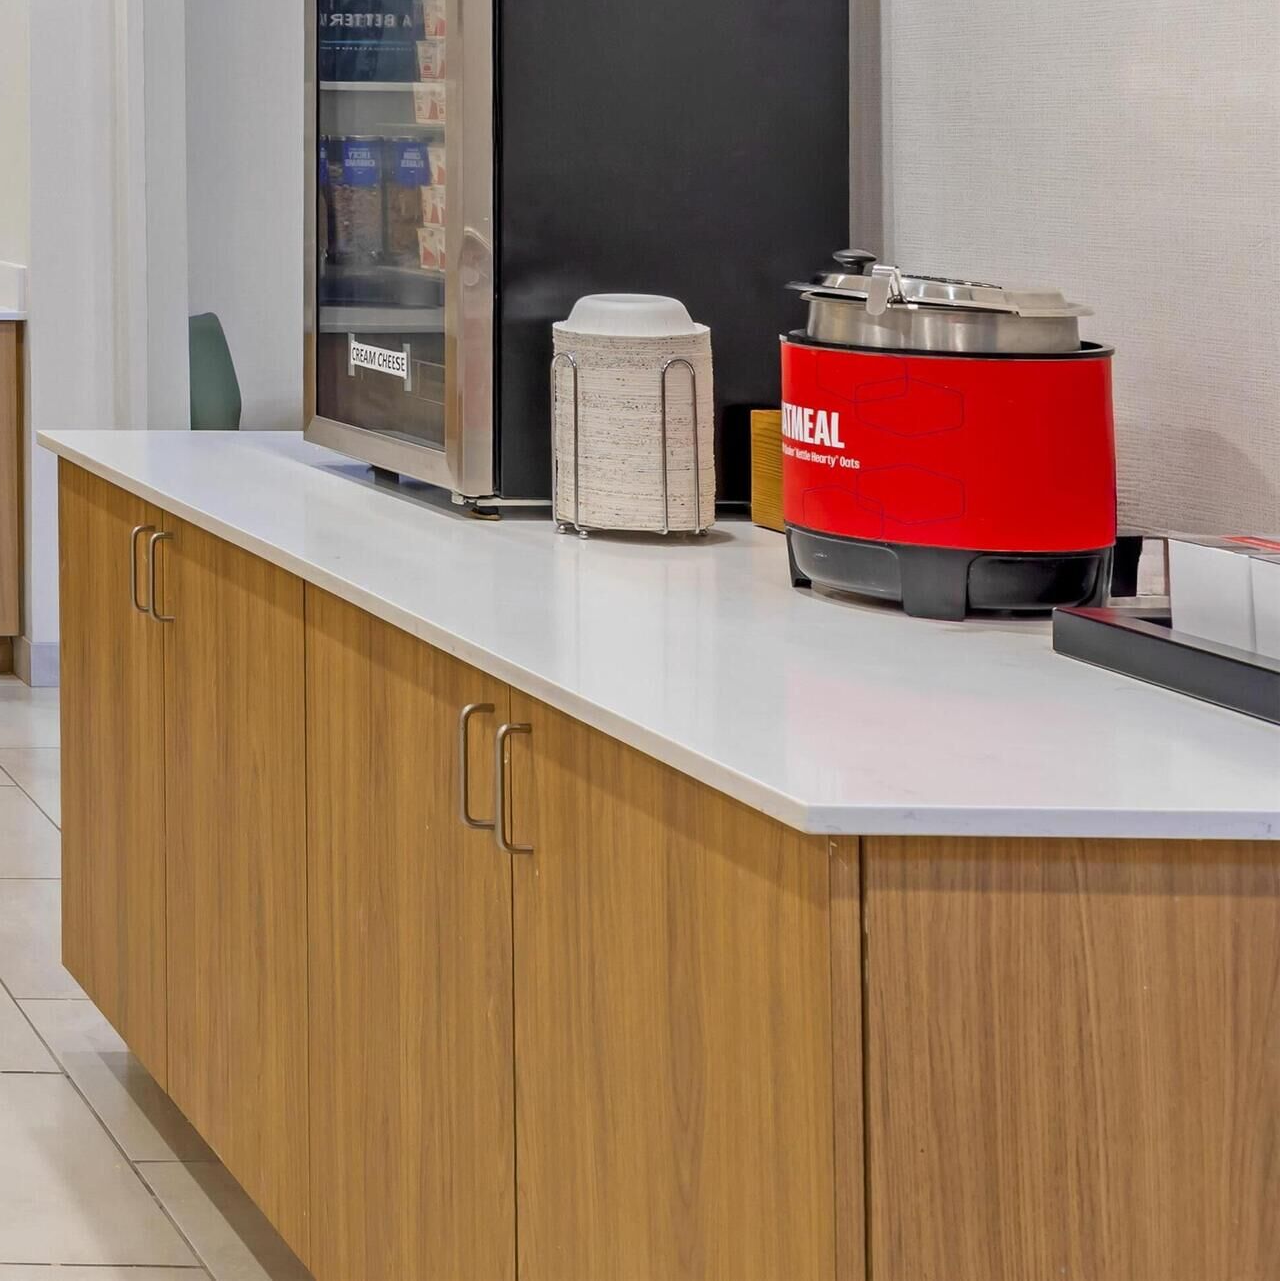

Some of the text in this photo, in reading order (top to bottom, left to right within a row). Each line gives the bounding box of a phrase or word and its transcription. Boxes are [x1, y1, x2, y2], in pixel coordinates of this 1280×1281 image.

[351, 347, 406, 372] CREAM CHEESE
[782, 401, 845, 449] ATMEAL
[839, 455, 860, 469] Oats
